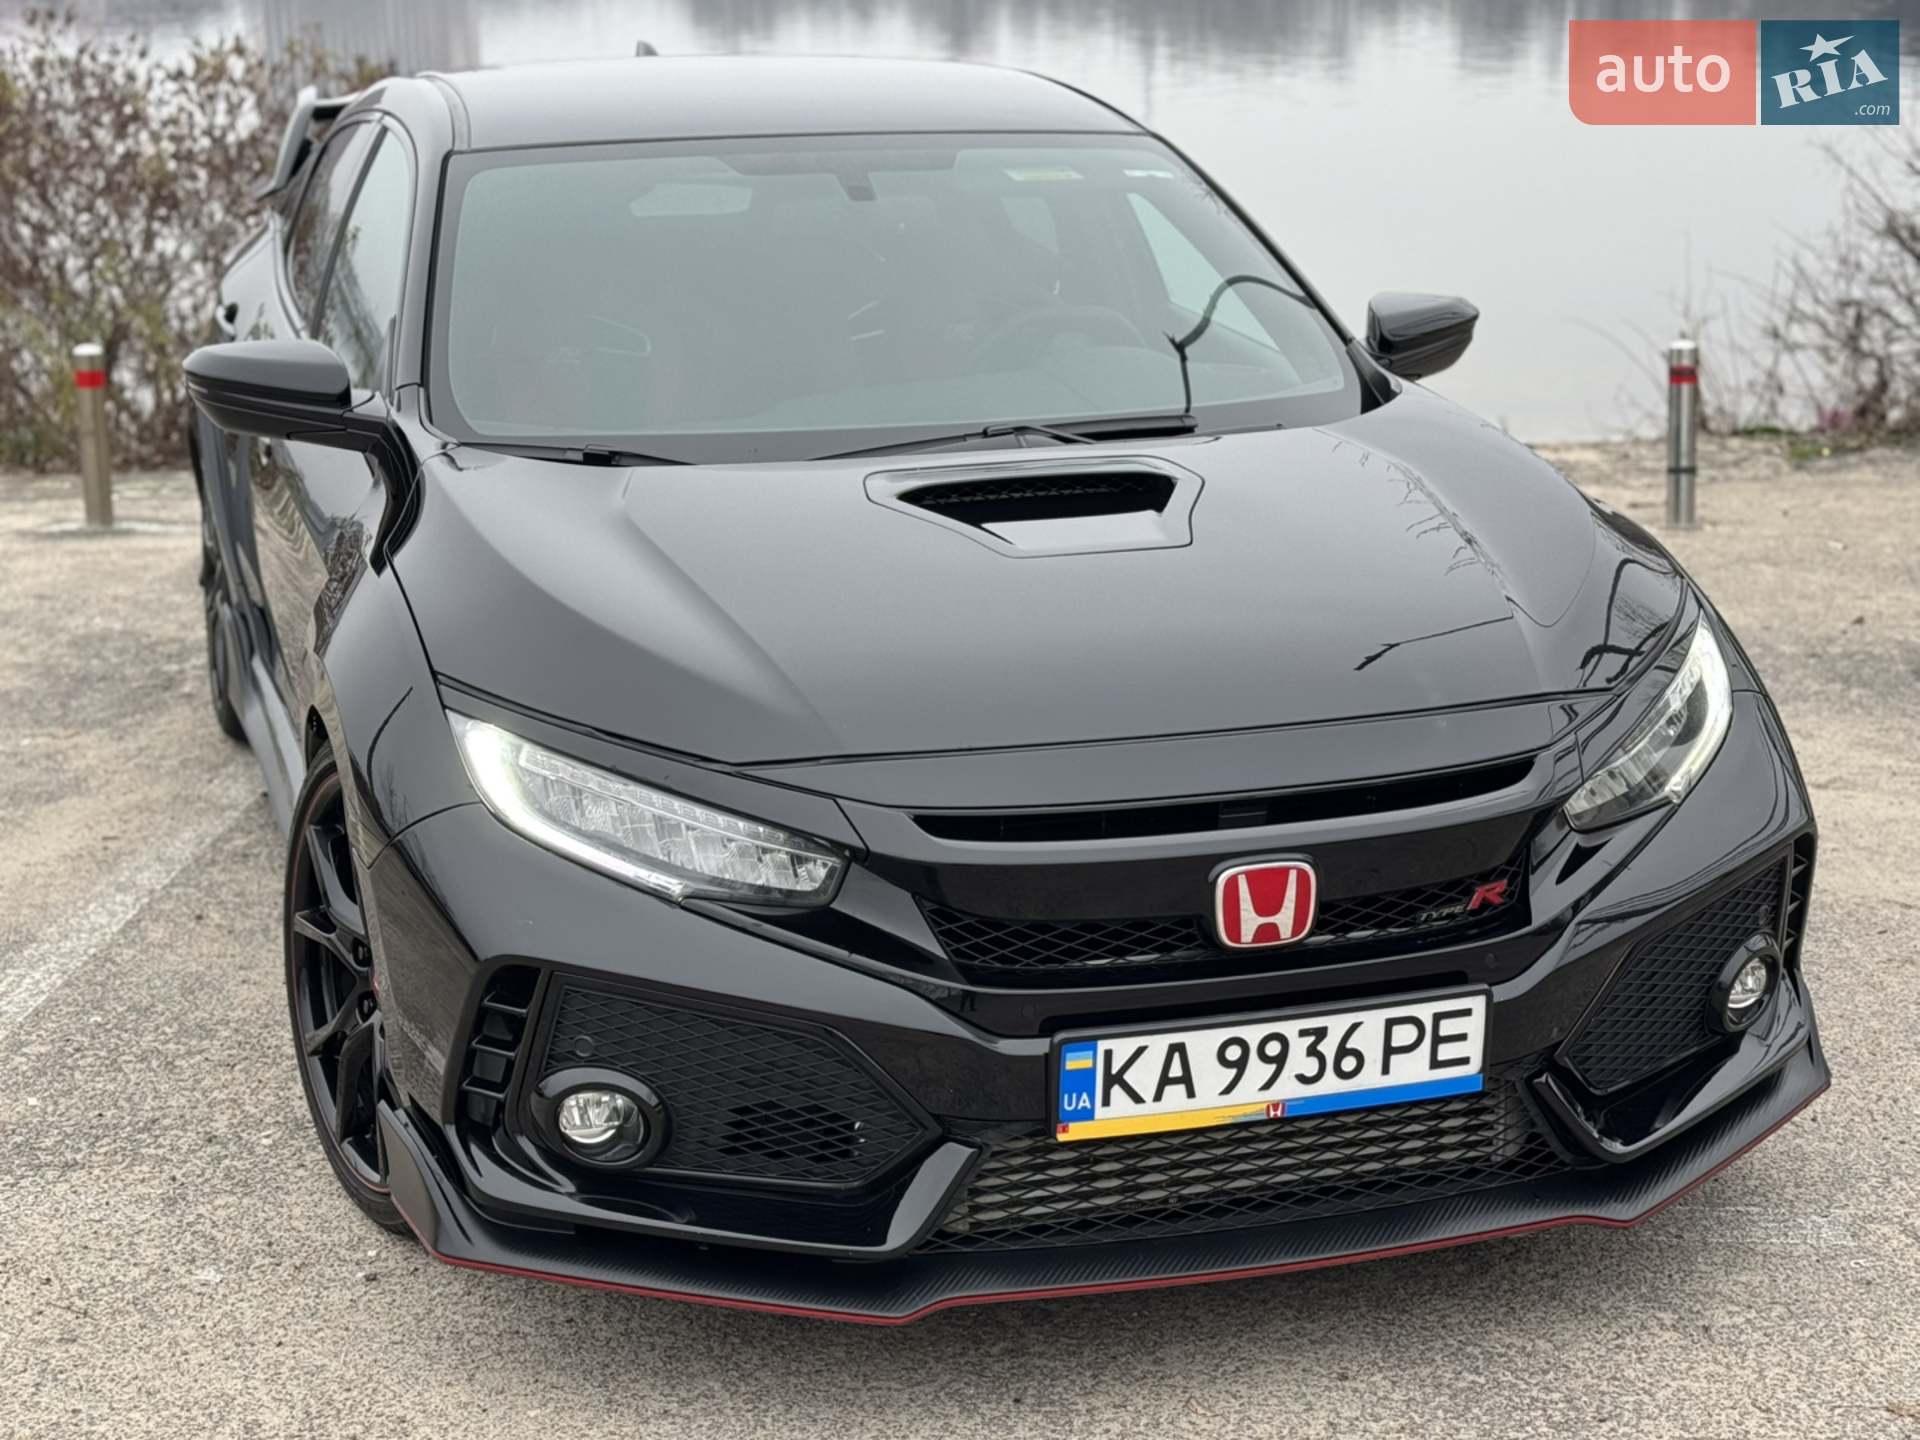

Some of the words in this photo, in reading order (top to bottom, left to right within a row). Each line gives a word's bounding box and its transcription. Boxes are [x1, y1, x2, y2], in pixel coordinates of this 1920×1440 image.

[1466, 878, 1508, 911] R
[1100, 1041, 1197, 1108] KA
[1216, 1020, 1366, 1096] 9936
[1381, 1007, 1474, 1076] PE
[1063, 1091, 1092, 1112] UA
